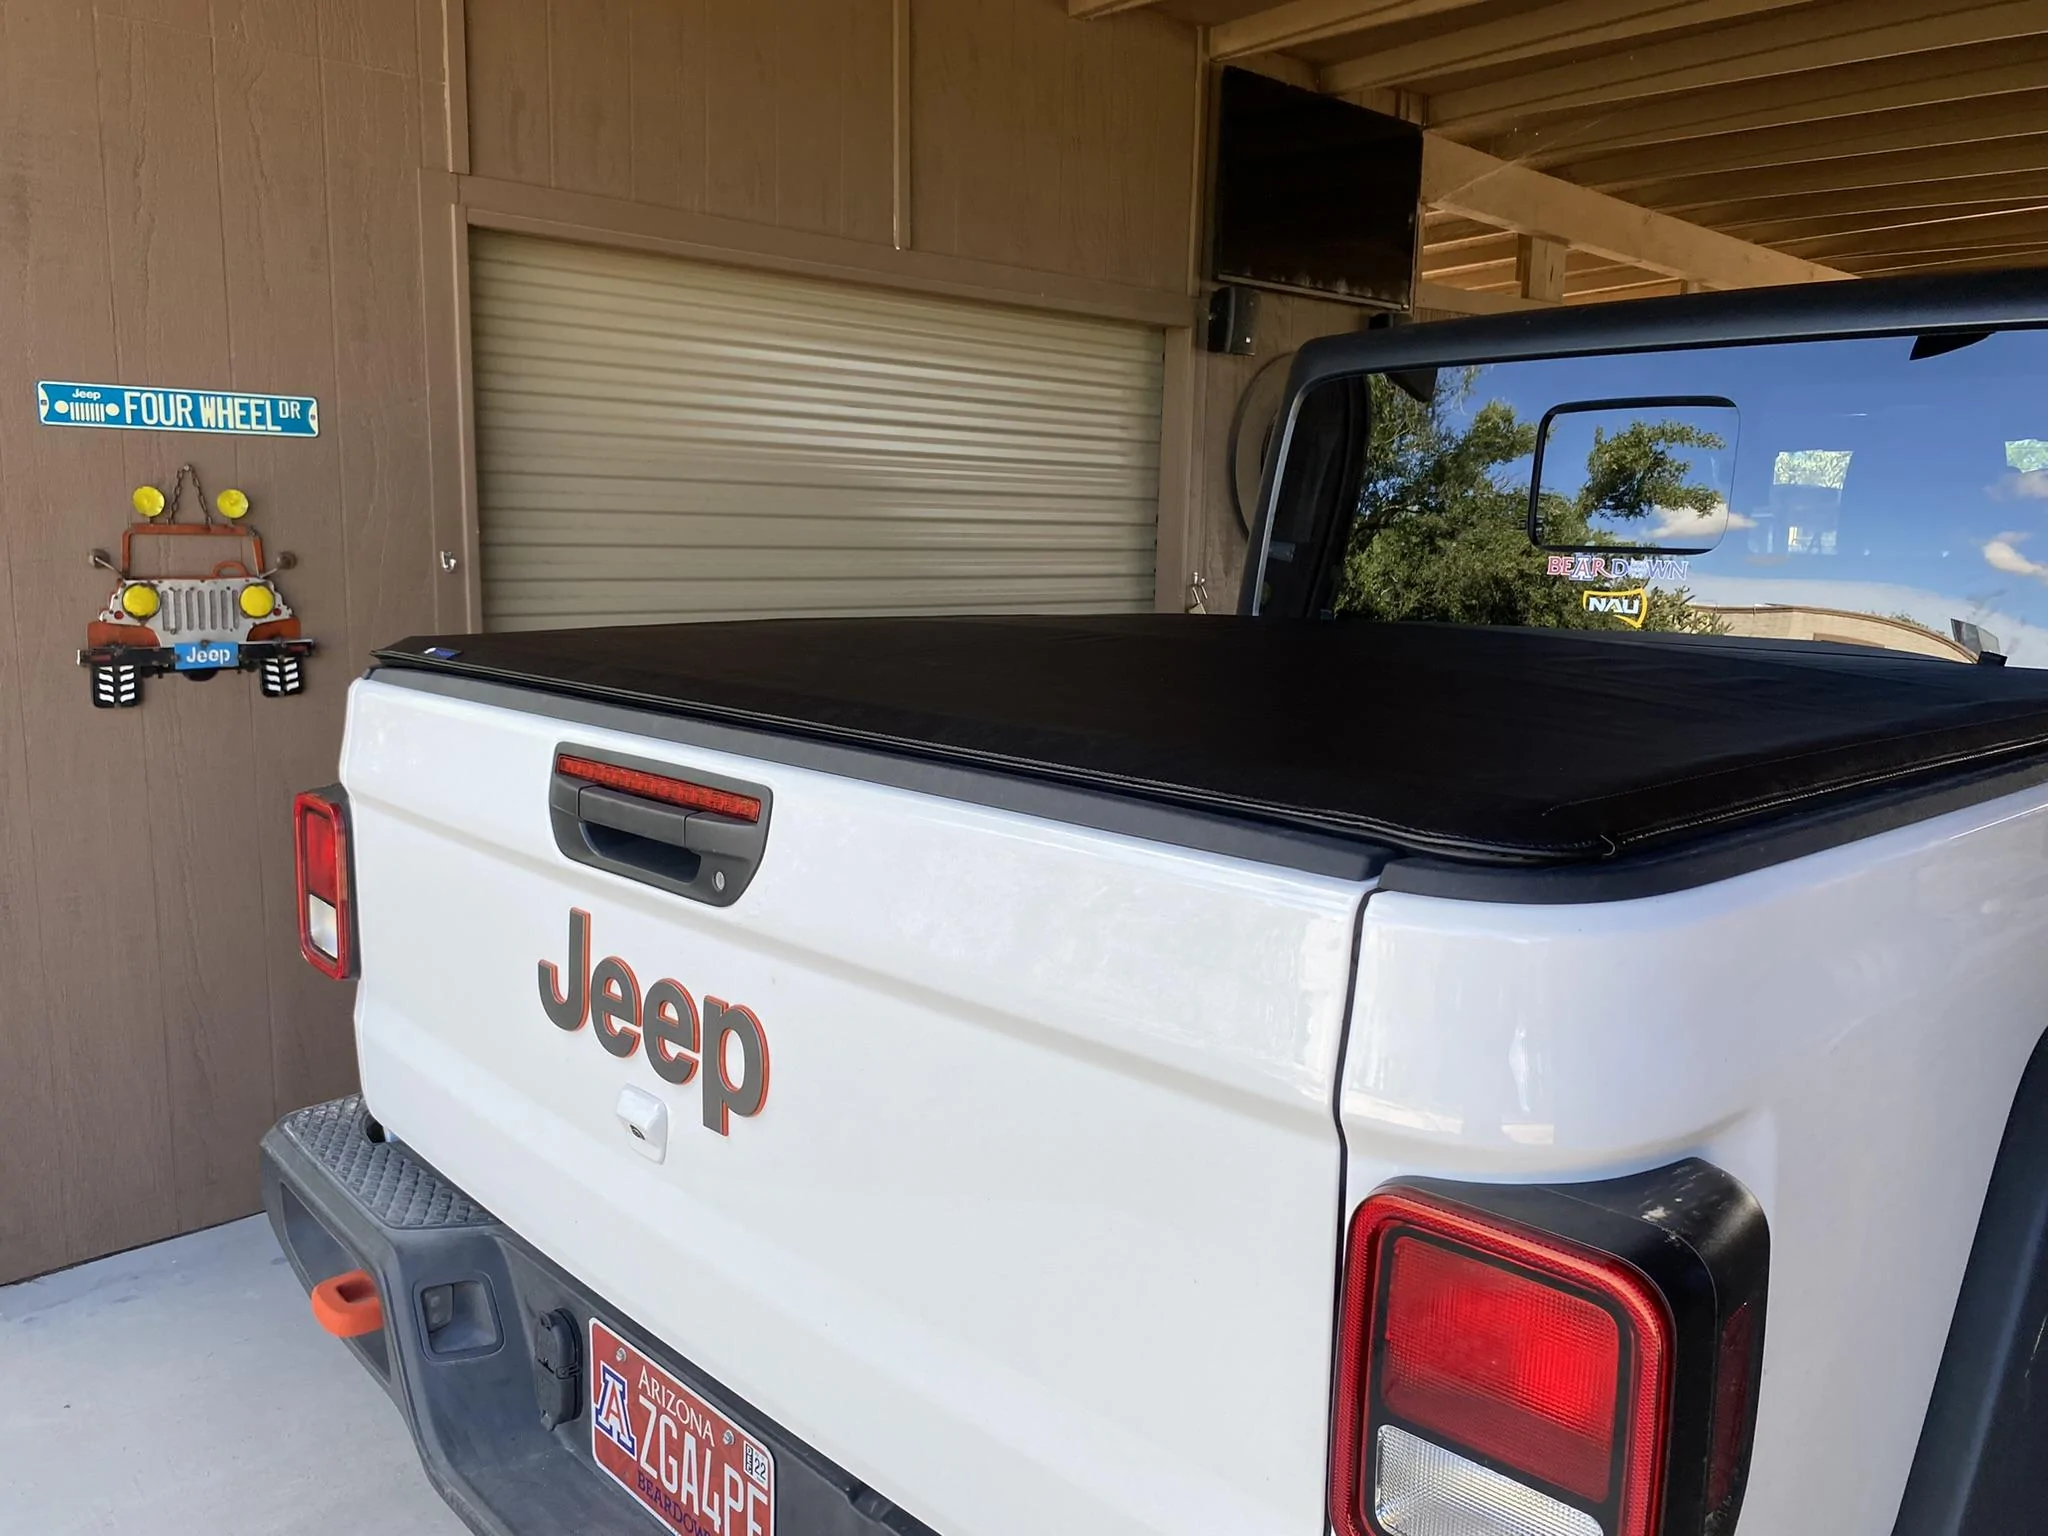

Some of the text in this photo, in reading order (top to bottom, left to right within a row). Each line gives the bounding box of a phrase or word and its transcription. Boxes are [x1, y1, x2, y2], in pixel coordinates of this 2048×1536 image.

[72, 388, 101, 401] Jeep
[124, 391, 301, 432] FOUR WHEEL DR
[1547, 555, 1690, 581] BEAR DWN
[1588, 597, 1641, 614] NAU
[186, 647, 230, 664] Jeep
[537, 906, 770, 1137] Jeep
[638, 1365, 715, 1448] ARIZONA
[754, 1457, 766, 1481] 22
